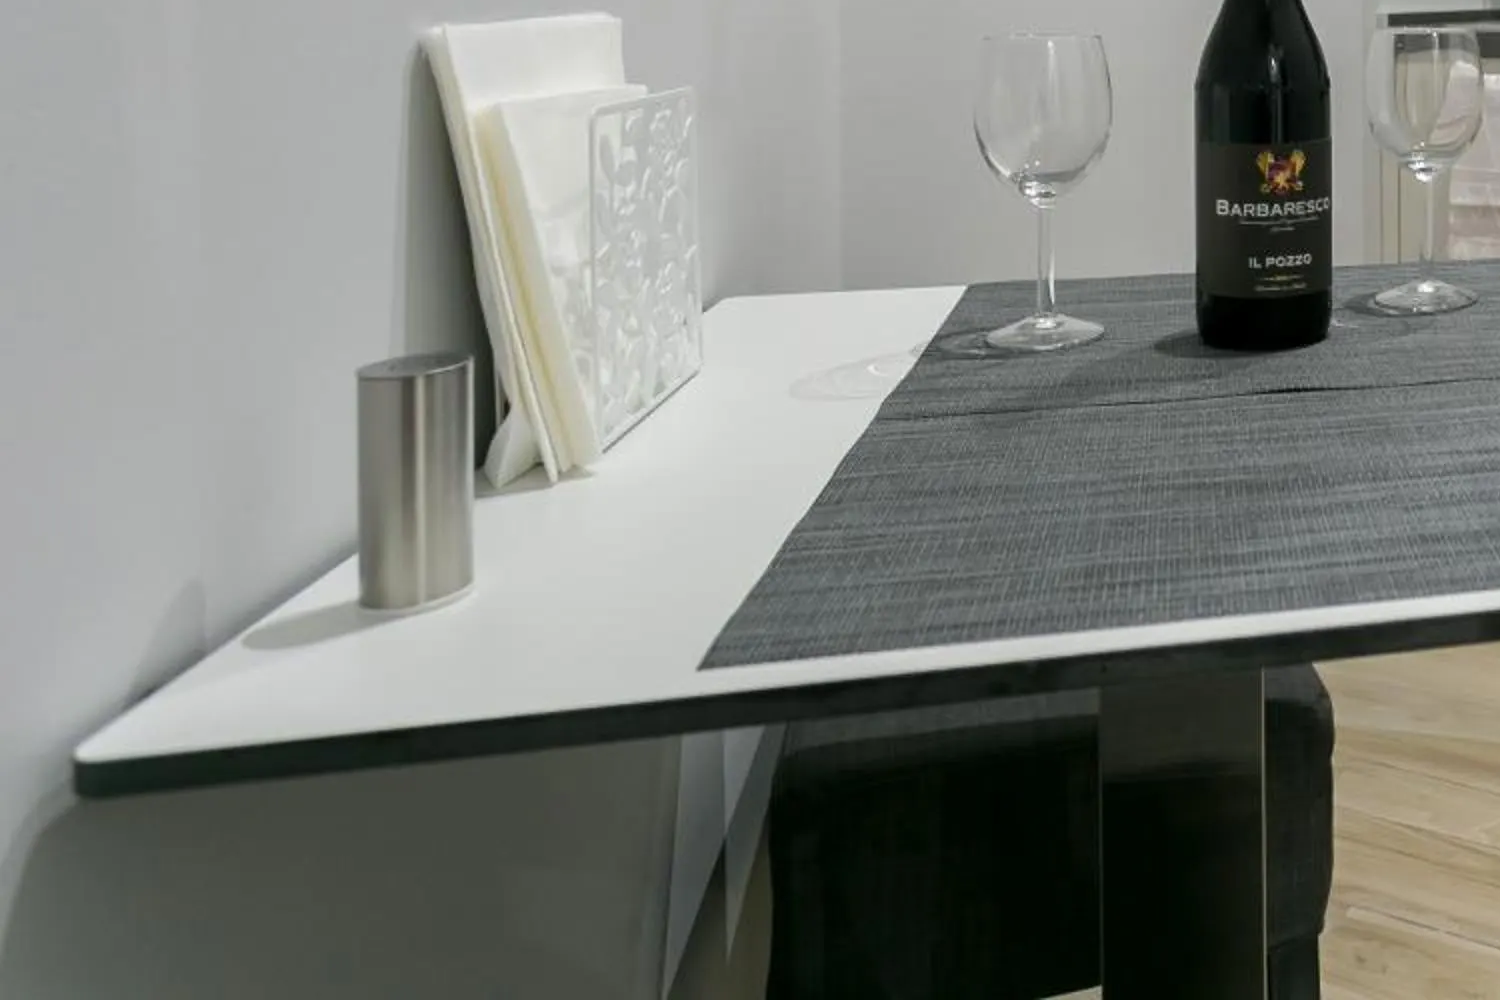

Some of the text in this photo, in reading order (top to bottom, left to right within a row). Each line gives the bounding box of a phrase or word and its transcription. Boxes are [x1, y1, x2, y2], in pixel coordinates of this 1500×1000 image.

[1216, 197, 1330, 217] BARBARESCO
[1248, 253, 1312, 269] IL POZZO
